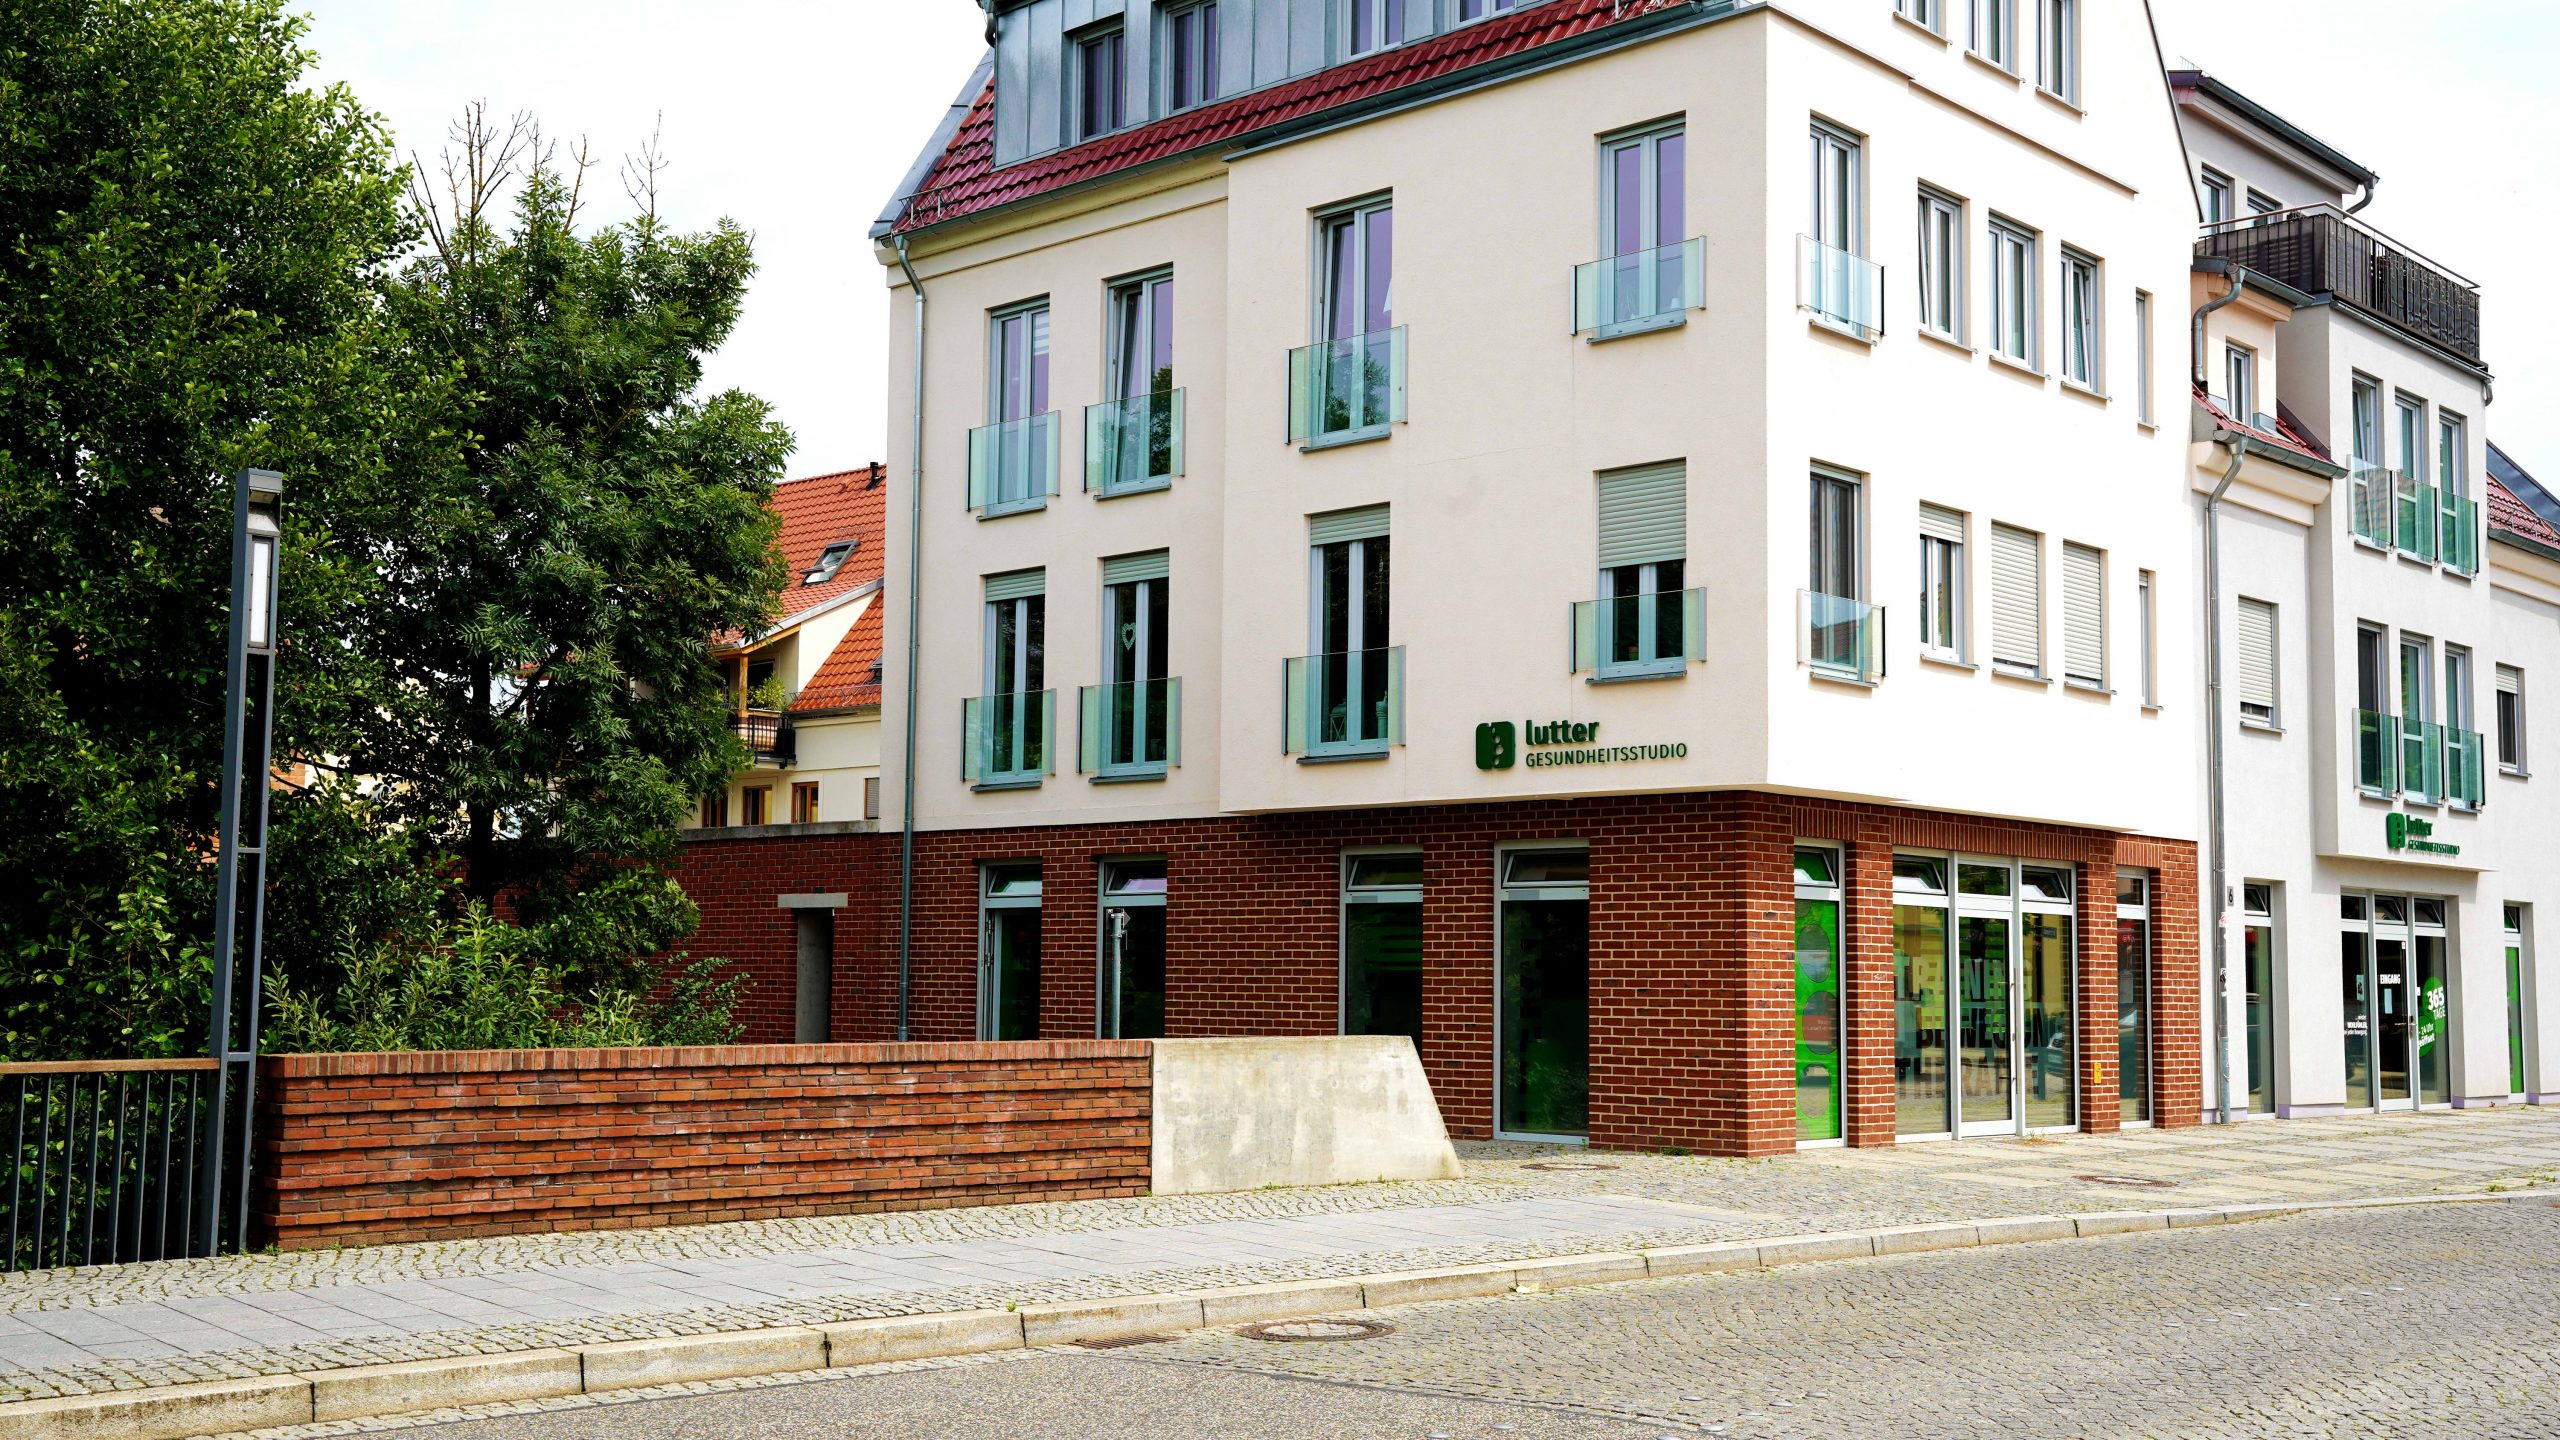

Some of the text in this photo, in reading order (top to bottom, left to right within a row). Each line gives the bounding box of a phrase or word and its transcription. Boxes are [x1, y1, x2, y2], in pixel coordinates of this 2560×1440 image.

[1525, 720, 1600, 746] lutter
[1525, 742, 1688, 768] GESUNDHEITSSTUDIO
[2228, 888, 2234, 903] 6
[1894, 956, 2033, 1000] TRANING
[2380, 973, 2401, 985] EINGANG
[2427, 986, 2445, 1011] 365
[2433, 1005, 2446, 1020] TAGE
